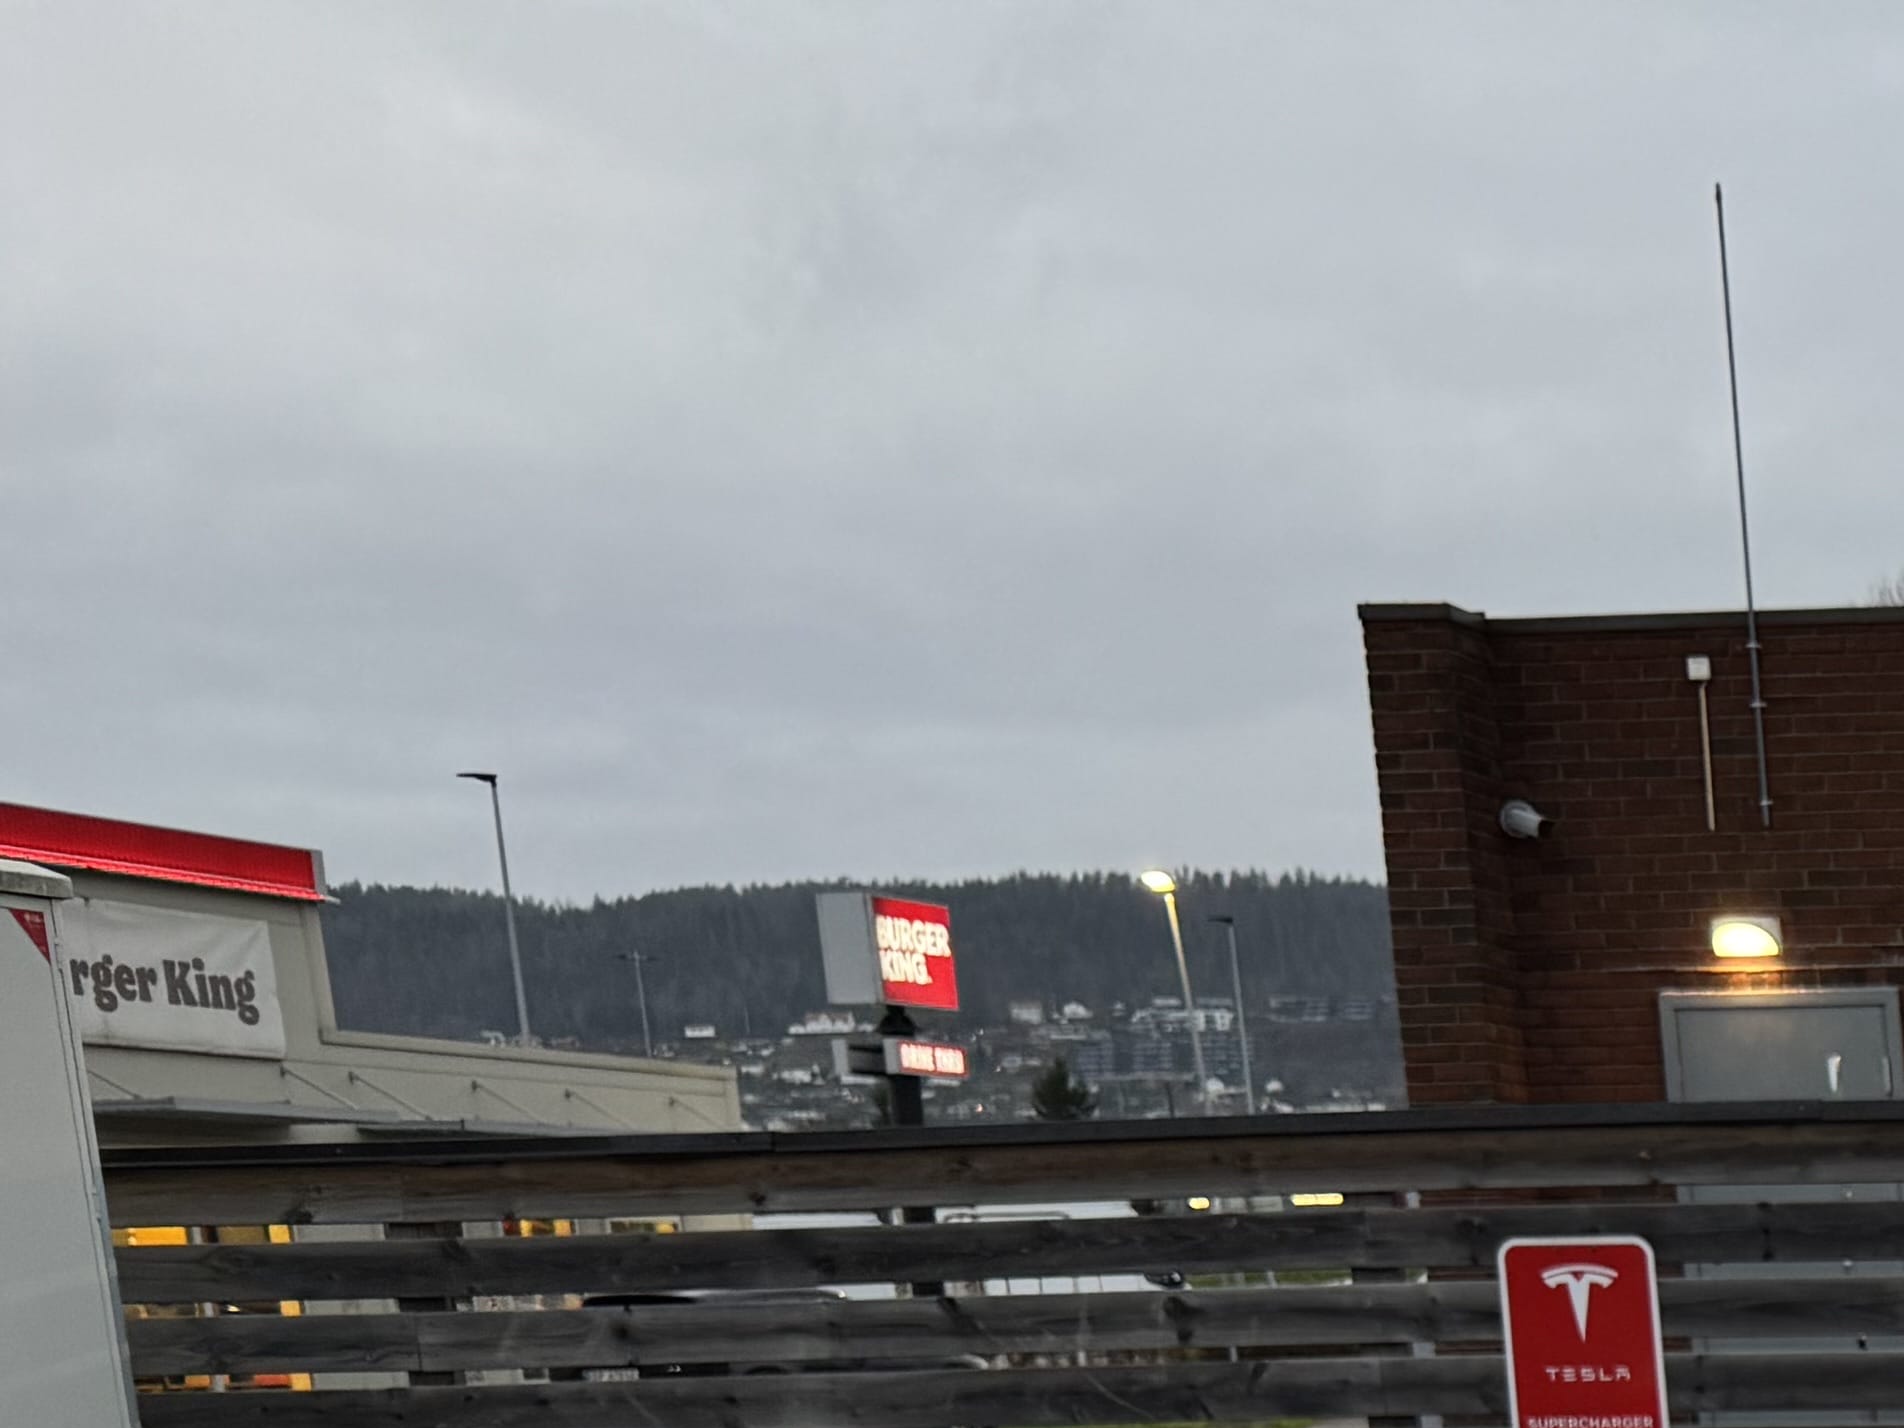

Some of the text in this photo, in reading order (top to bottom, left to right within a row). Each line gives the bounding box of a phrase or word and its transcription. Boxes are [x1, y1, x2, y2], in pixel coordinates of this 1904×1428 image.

[876, 915, 952, 957] BURGER
[162, 957, 260, 1026] King
[1544, 1365, 1632, 1382] TESLA
